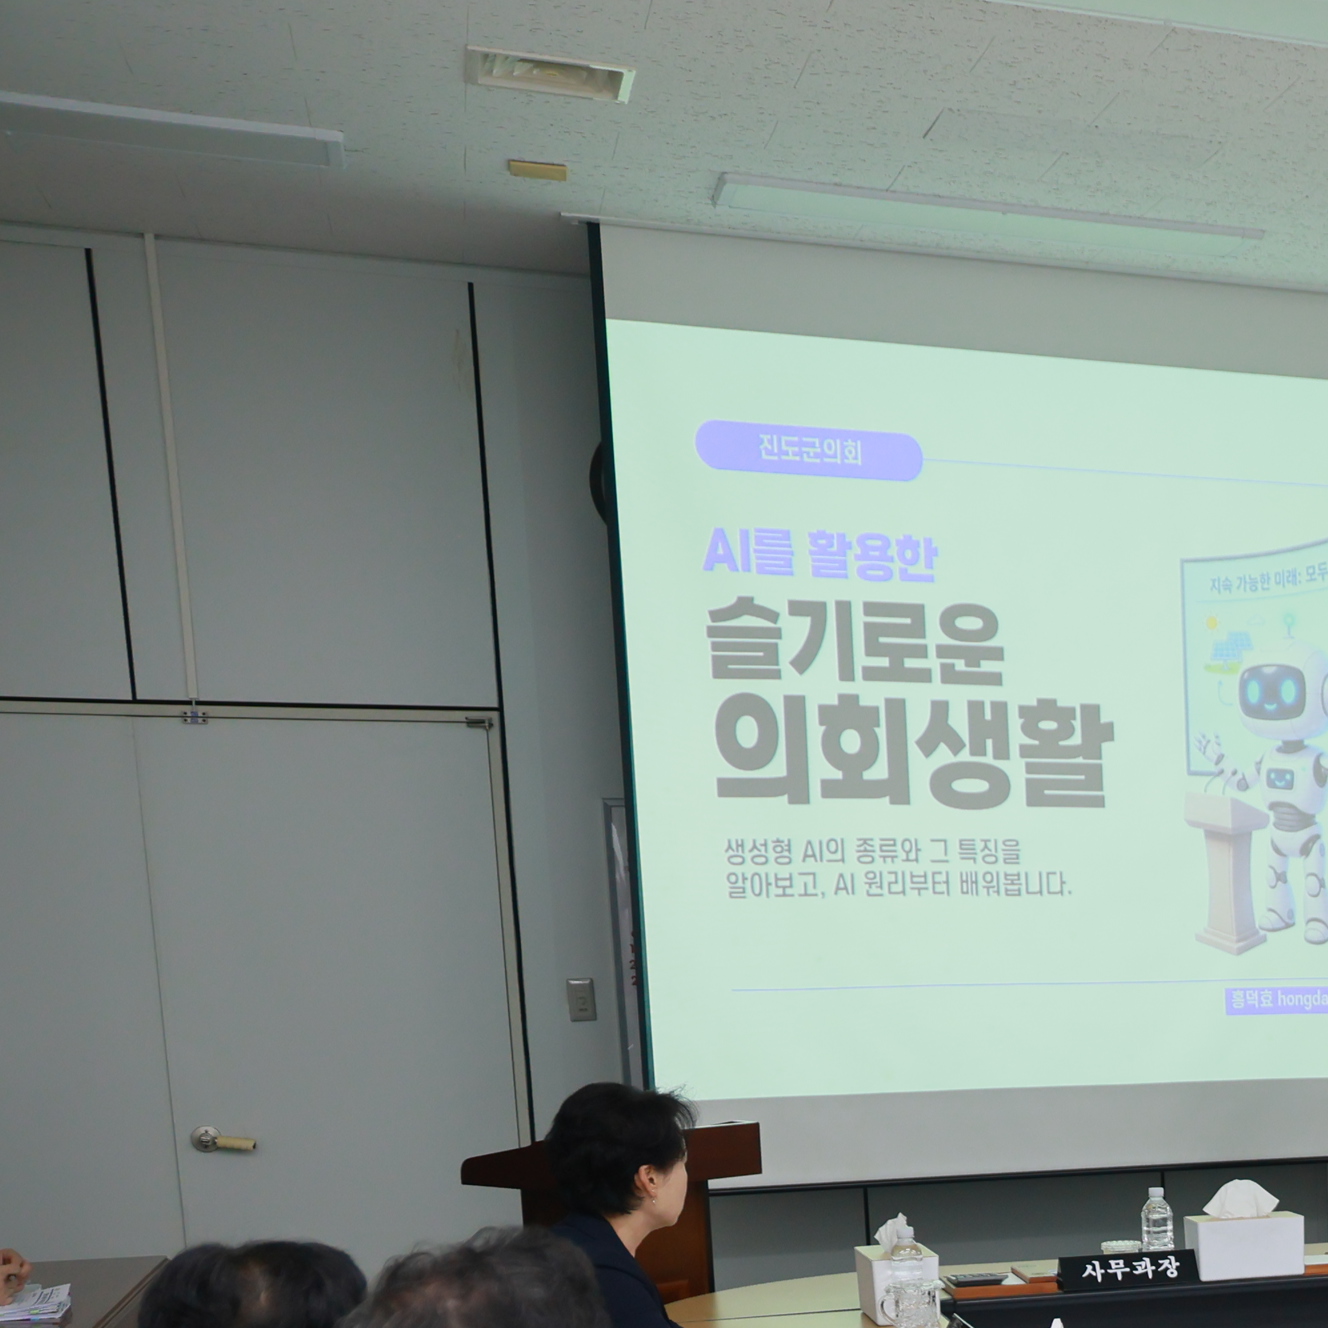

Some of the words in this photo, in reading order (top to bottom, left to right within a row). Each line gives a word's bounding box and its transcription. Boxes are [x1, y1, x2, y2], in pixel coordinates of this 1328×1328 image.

[759, 434, 862, 466] 진도군의회
[703, 527, 794, 577] AI를
[808, 529, 939, 583] 활용한
[1210, 577, 1233, 594] 지속
[1236, 572, 1271, 593] 가능한
[1274, 570, 1301, 588] 미래:
[706, 595, 1004, 687] 슬기로운
[715, 692, 1115, 810] 의회생활
[724, 837, 793, 866] 생성형
[801, 838, 846, 865] AI의
[855, 838, 922, 865] 종류와
[929, 839, 950, 864] 그
[957, 838, 1021, 866] 특징을
[726, 871, 826, 899] 알아보고,
[833, 872, 856, 897] AI
[864, 870, 950, 897] 원리부터
[959, 870, 1072, 898] 배워봅니다.
[1232, 990, 1273, 1009] 홍덕효
[1082, 1255, 1180, 1283] 사무과장
